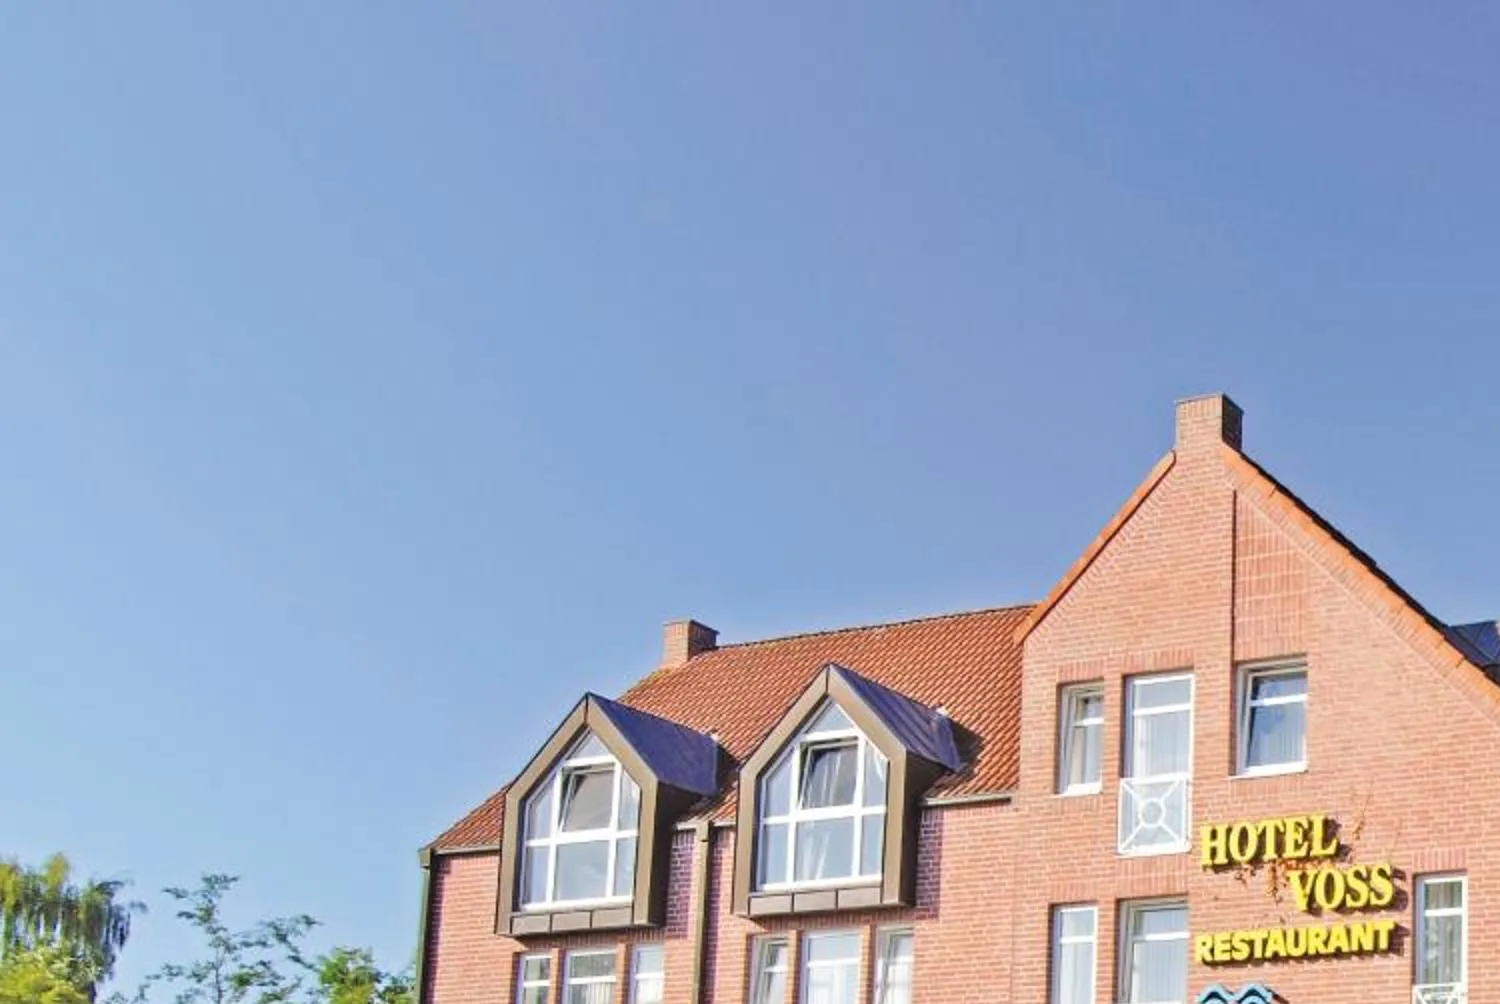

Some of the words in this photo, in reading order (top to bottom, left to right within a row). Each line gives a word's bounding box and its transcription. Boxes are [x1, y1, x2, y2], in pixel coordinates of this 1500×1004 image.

[1200, 814, 1340, 866] HOTEL
[1287, 863, 1395, 913] VOSS
[1195, 920, 1396, 963] RESTAURANT
